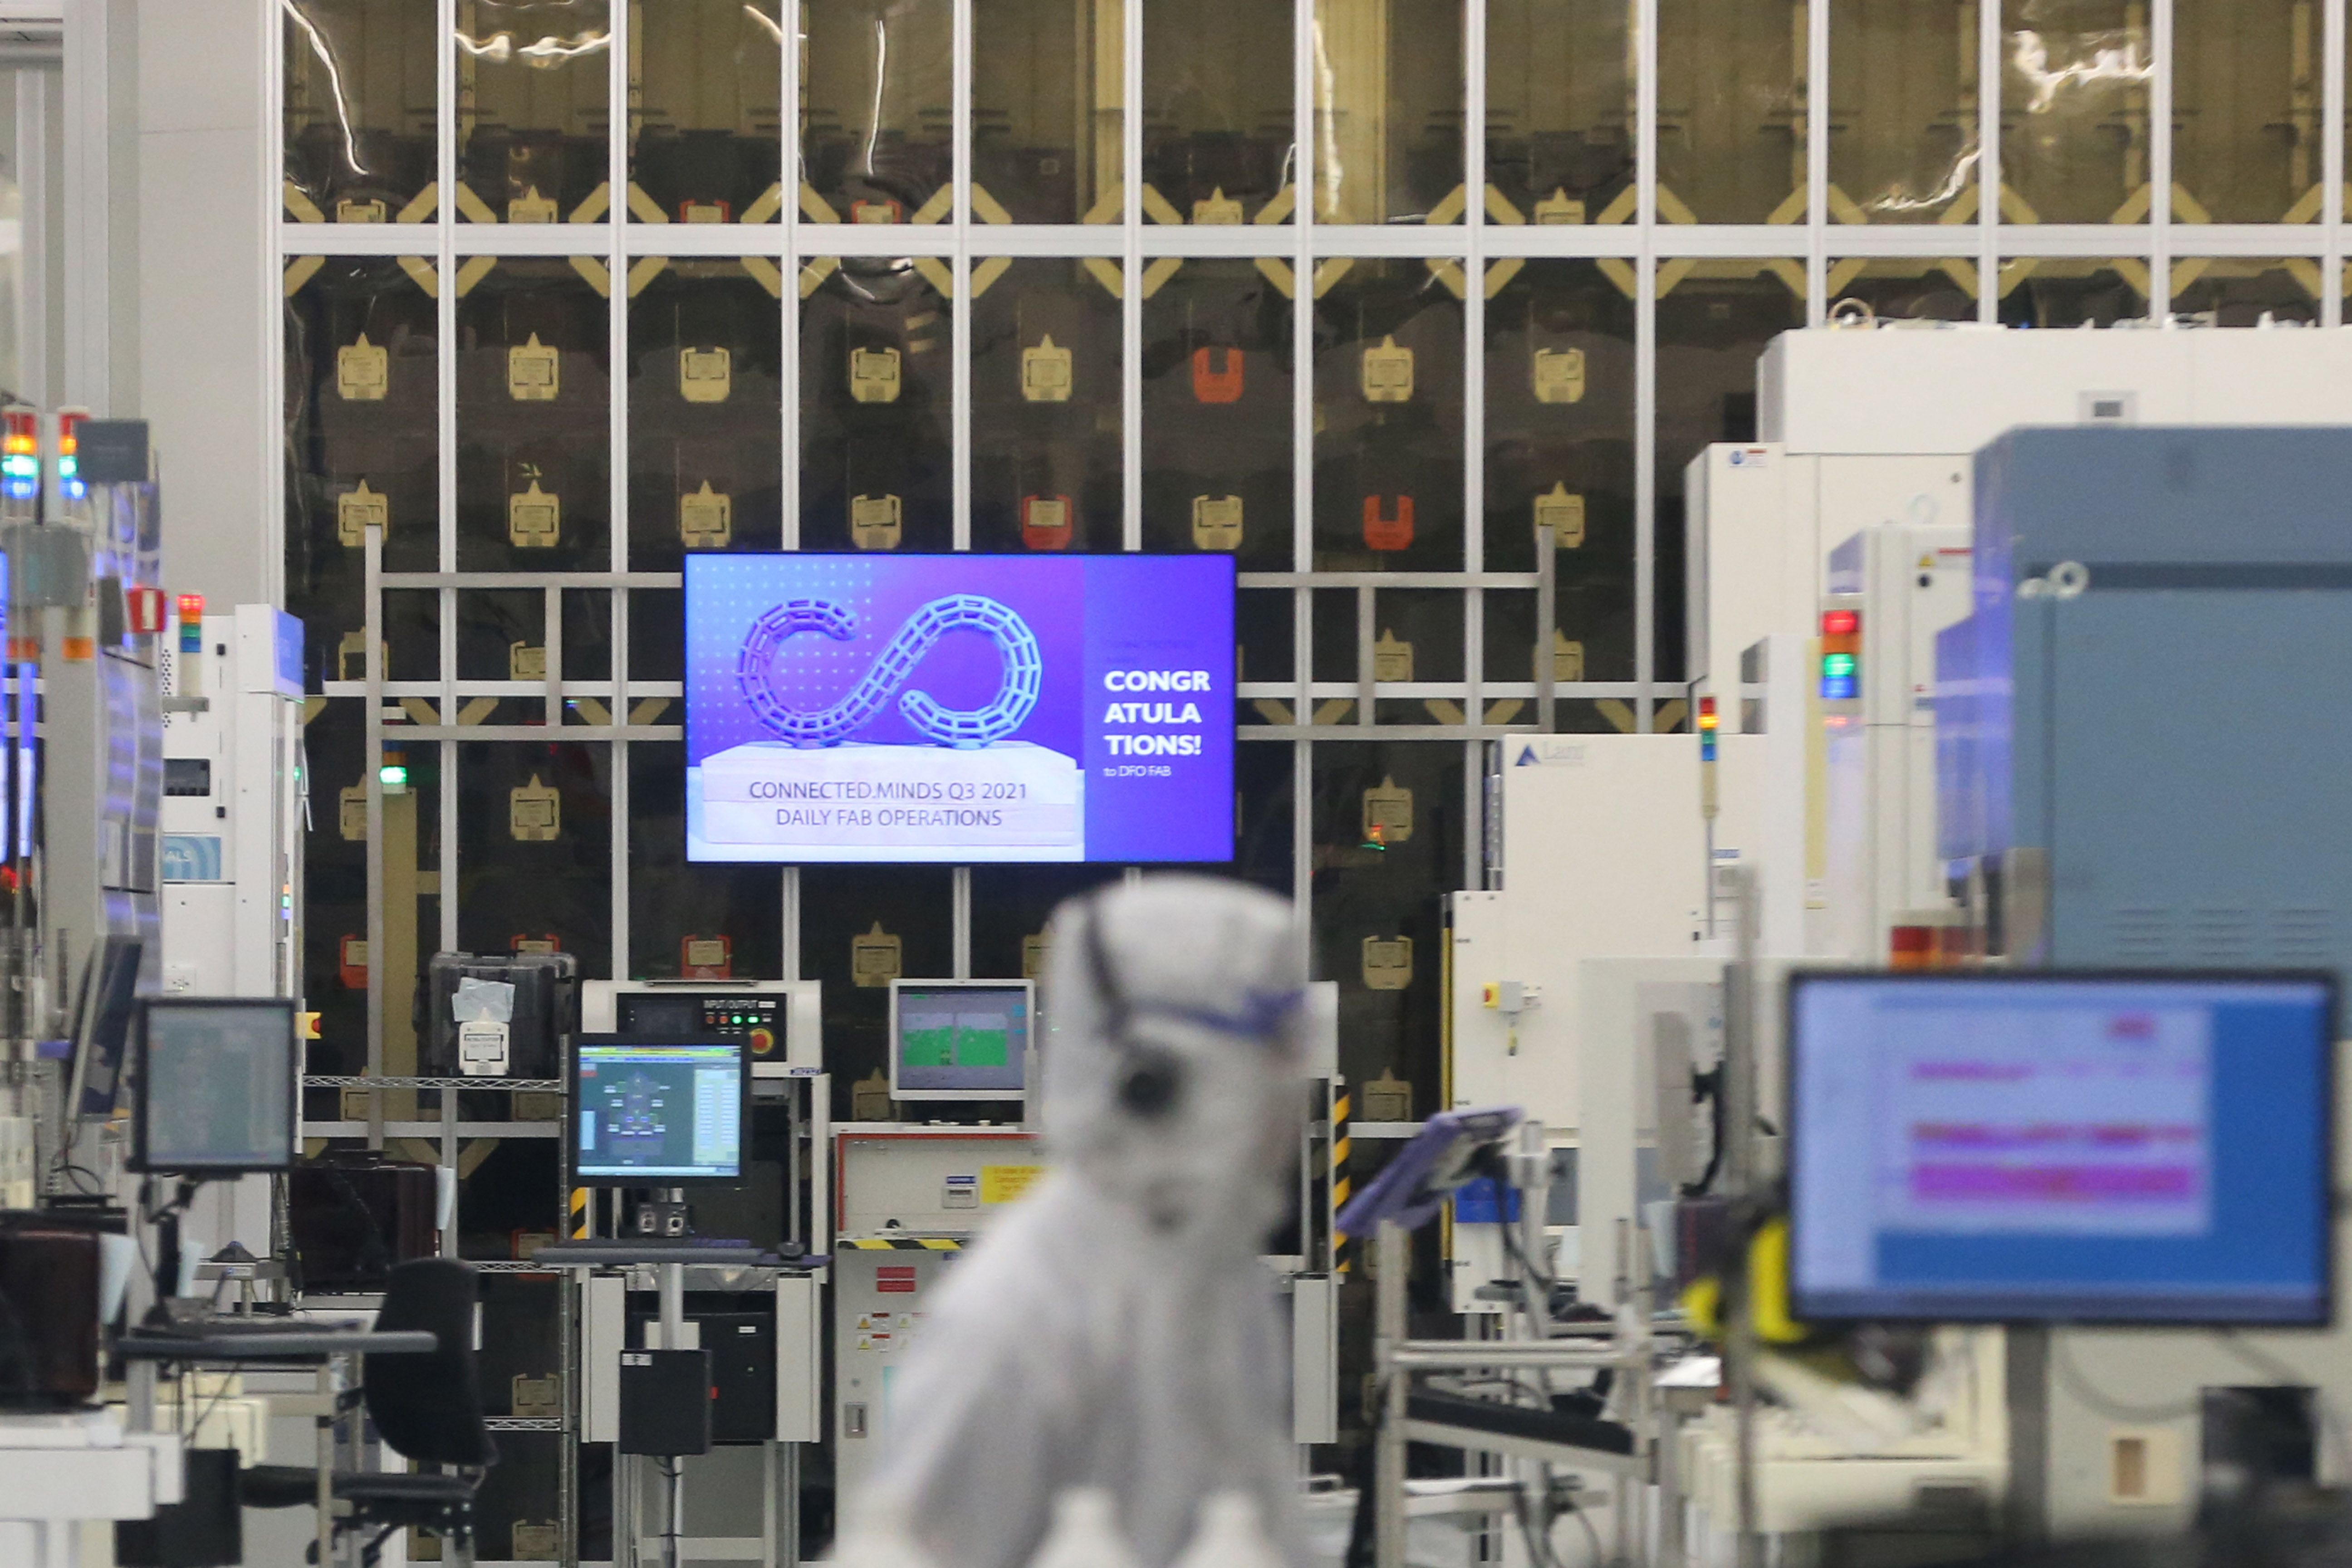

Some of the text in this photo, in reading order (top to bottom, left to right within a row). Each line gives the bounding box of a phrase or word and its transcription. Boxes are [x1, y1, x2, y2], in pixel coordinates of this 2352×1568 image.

[1103, 670, 1211, 691] CONGR
[1103, 703, 1202, 723] ATULA
[1103, 735, 1201, 755] TIONS!
[1103, 765, 1172, 777] to DFO FAB
[948, 782, 975, 800] Q3
[982, 783, 1026, 799] 2021
[776, 809, 1002, 826] DAILY FAB OPERATIONS
